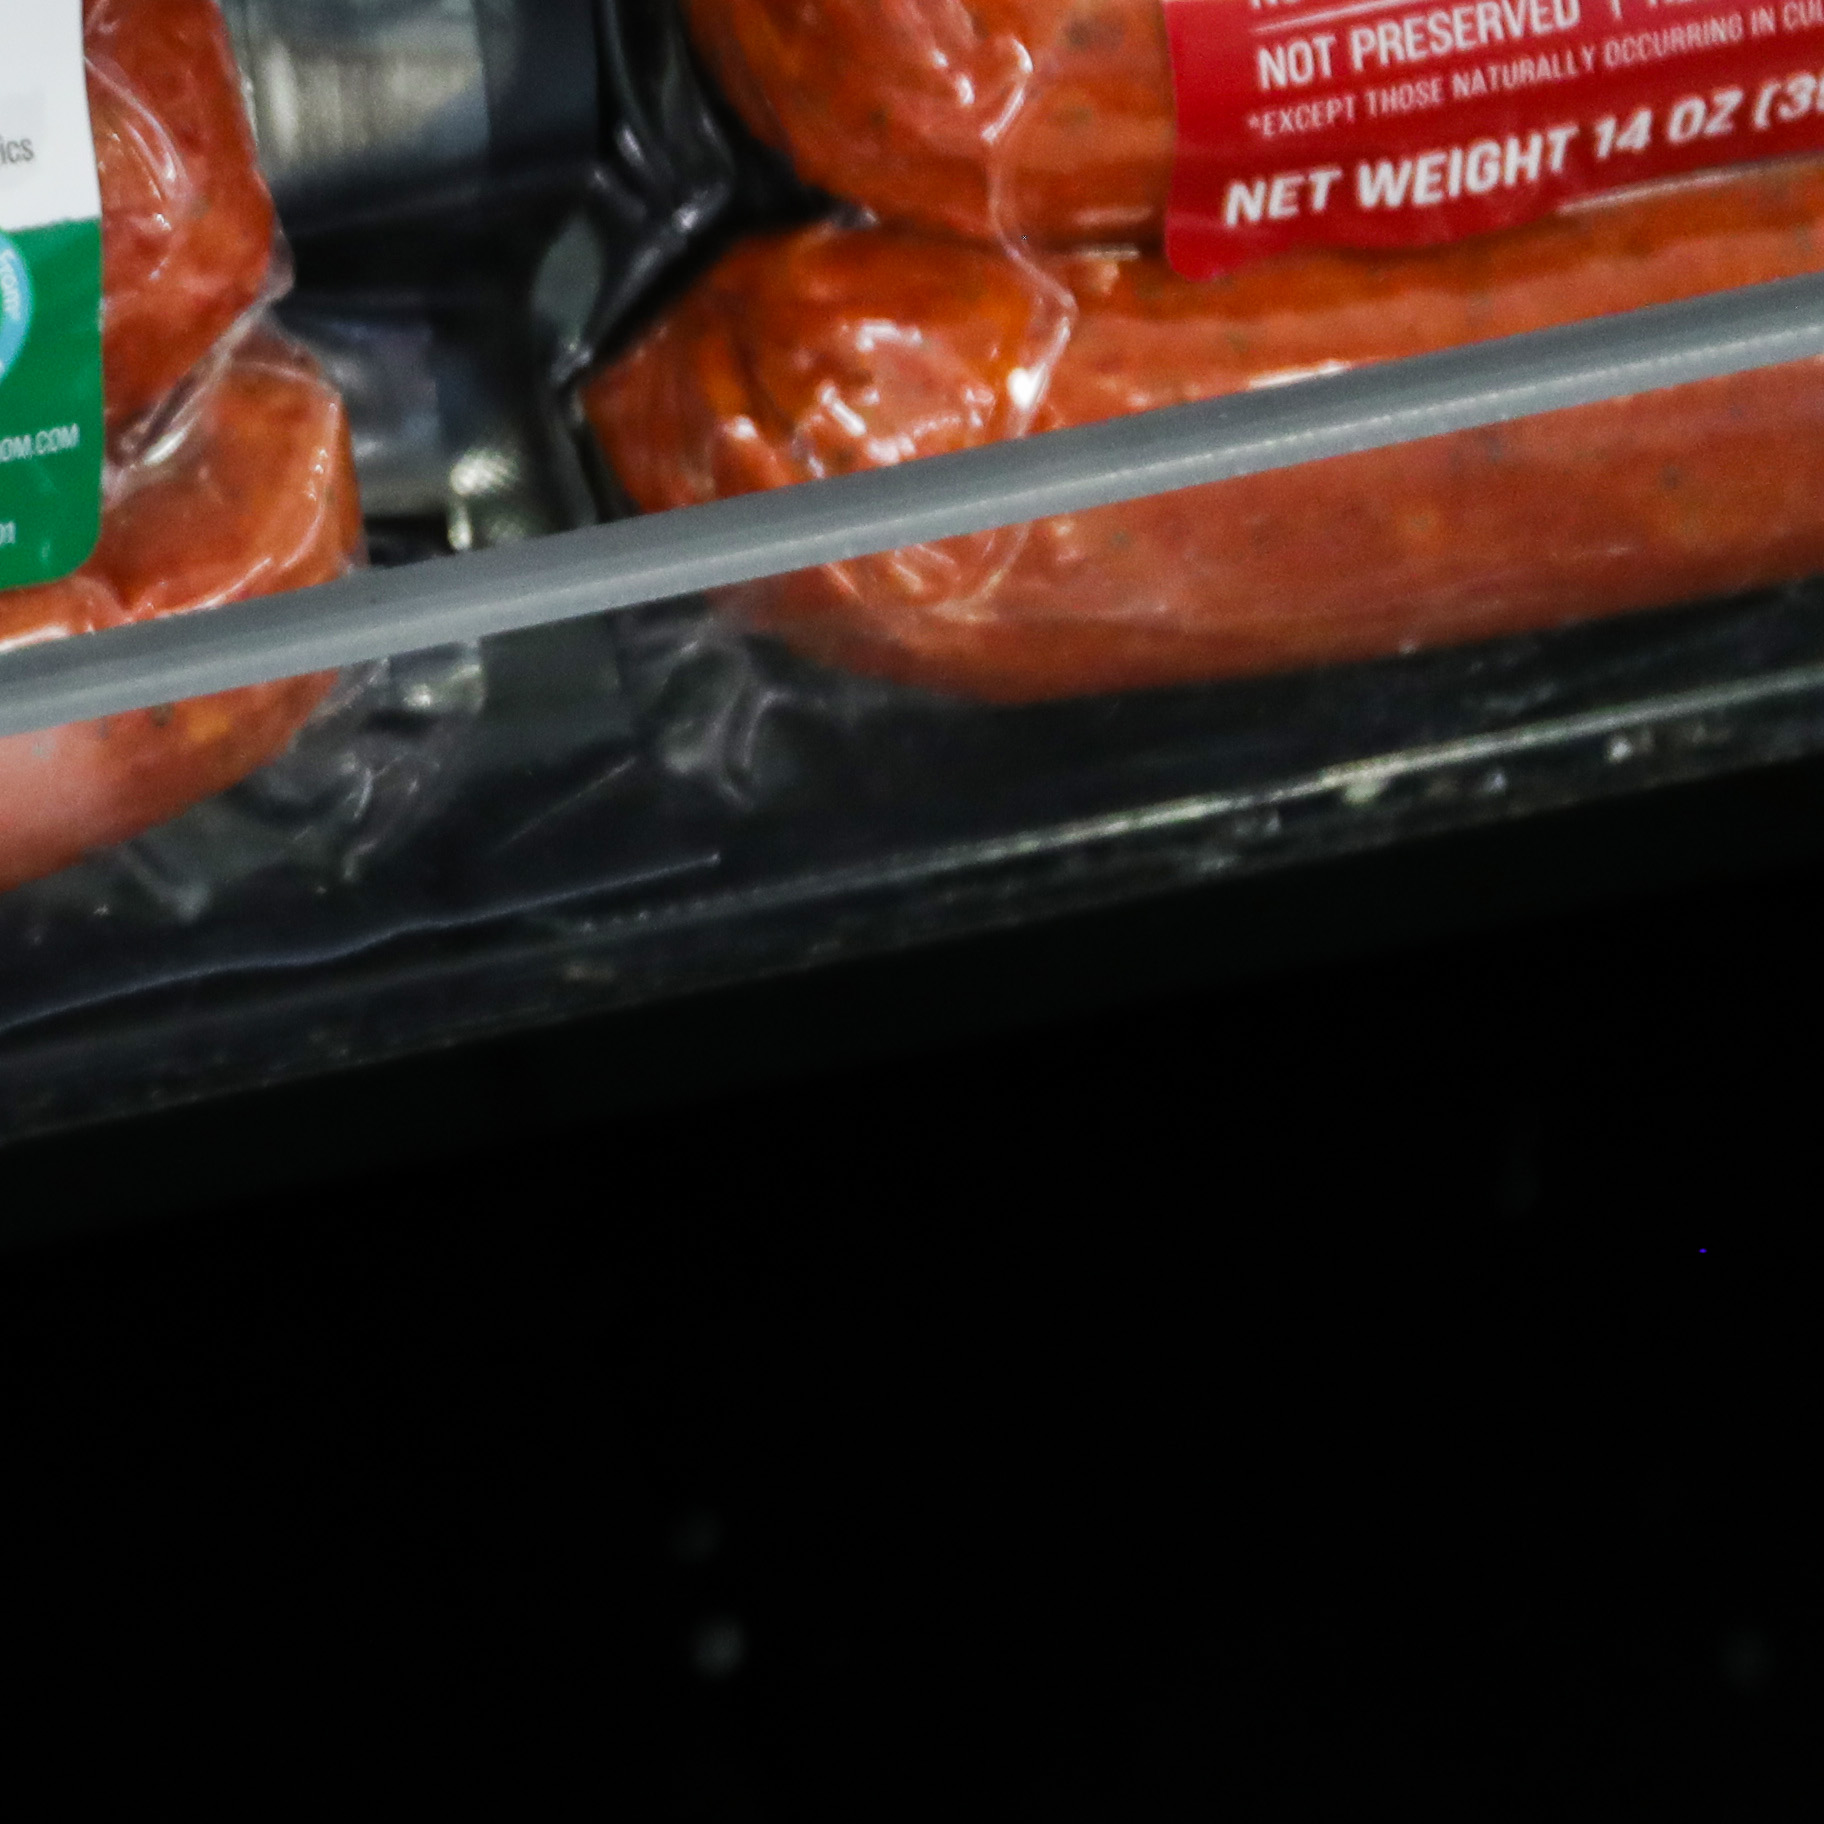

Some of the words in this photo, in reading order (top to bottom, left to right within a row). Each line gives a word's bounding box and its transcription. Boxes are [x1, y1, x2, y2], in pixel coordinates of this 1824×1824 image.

[1257, 32, 1337, 91] NOT
[1363, 77, 1447, 119] THOSE
[1451, 42, 1597, 100] NATURALLY
[1602, 12, 1746, 70] OCCURRING
[1750, 5, 1777, 38] IN
[1223, 165, 1345, 229] NET
[1355, 123, 1582, 210] WEIGHT
[1592, 108, 1656, 162] 14
[1666, 87, 1745, 146] OZ
